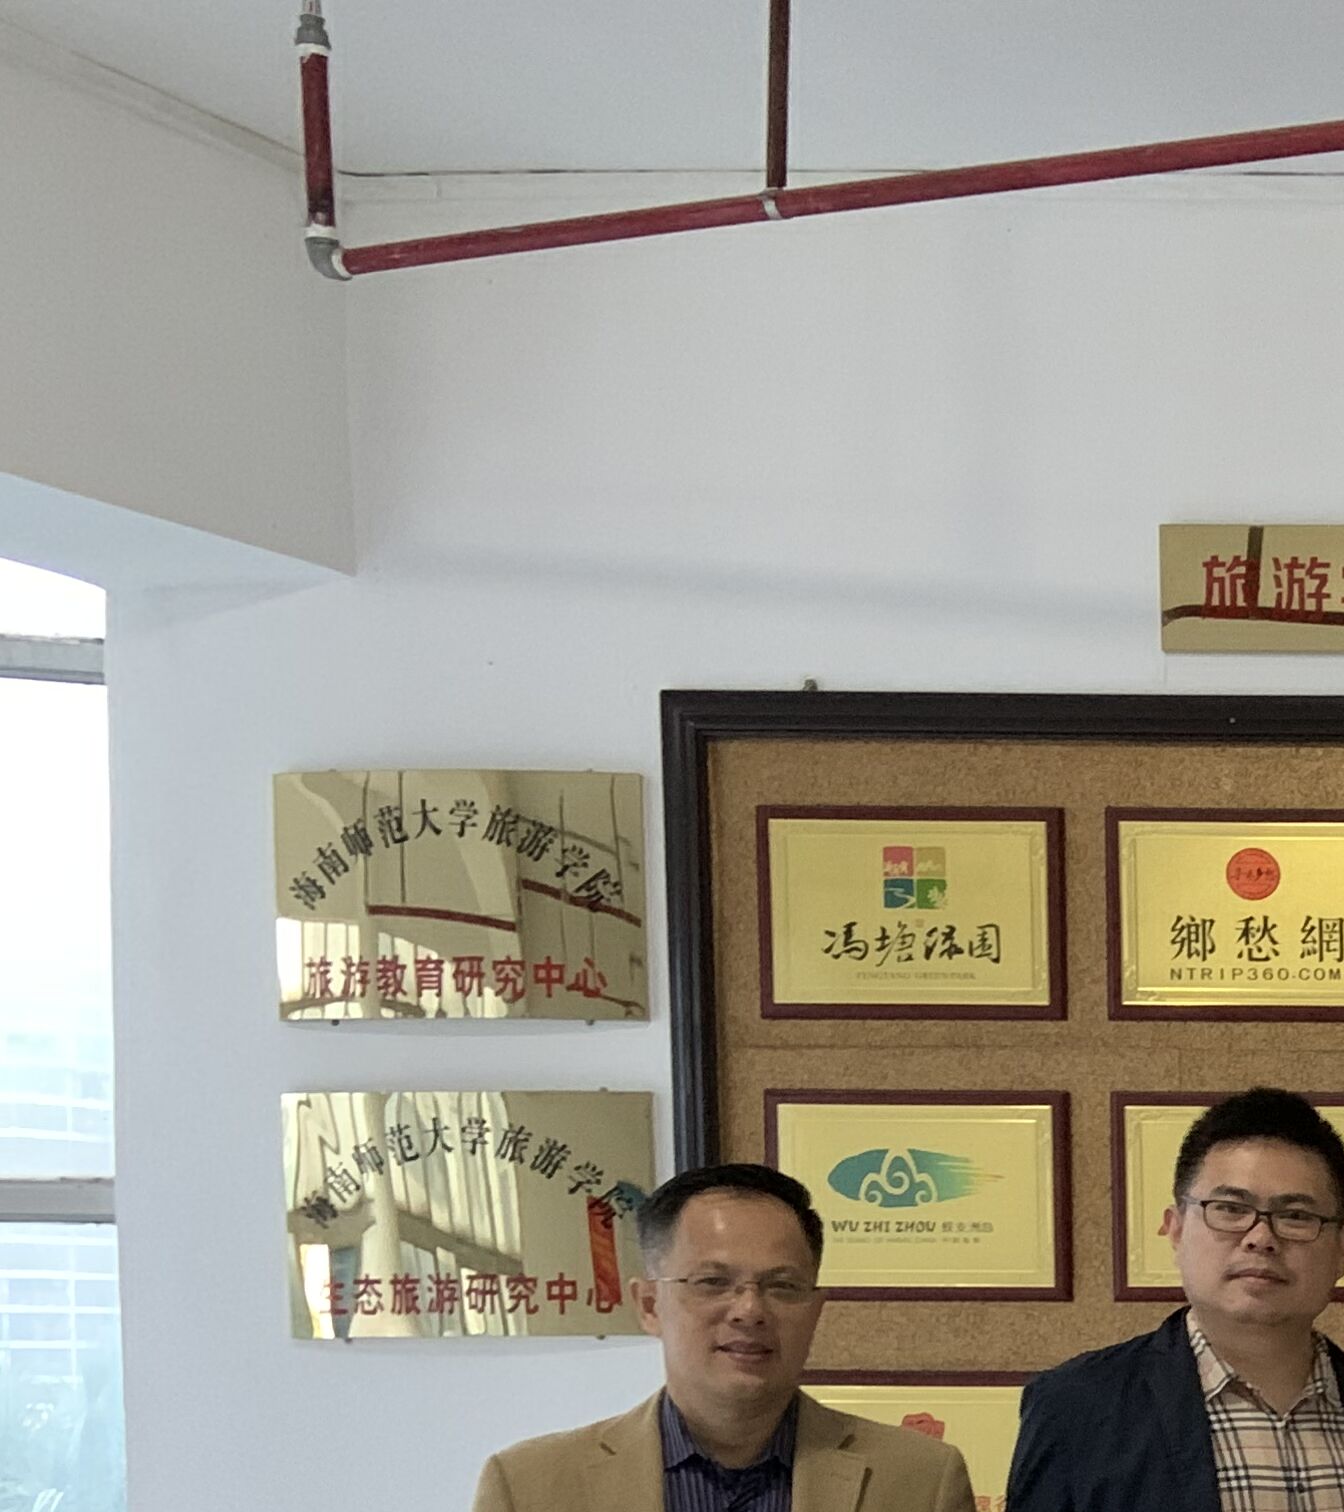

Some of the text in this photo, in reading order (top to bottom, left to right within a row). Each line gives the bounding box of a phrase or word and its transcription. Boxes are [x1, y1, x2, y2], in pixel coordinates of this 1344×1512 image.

[289, 799, 624, 910] 海南师范大学旅游学院
[305, 955, 607, 1000] 旅游教育研究中心
[1170, 967, 1342, 981] NTRIP360.COM
[831, 1220, 859, 1233] WU
[863, 1221, 890, 1233] ZHI
[895, 1221, 936, 1233] ZHOU
[322, 1272, 623, 1315] 生态旅游研究中心
